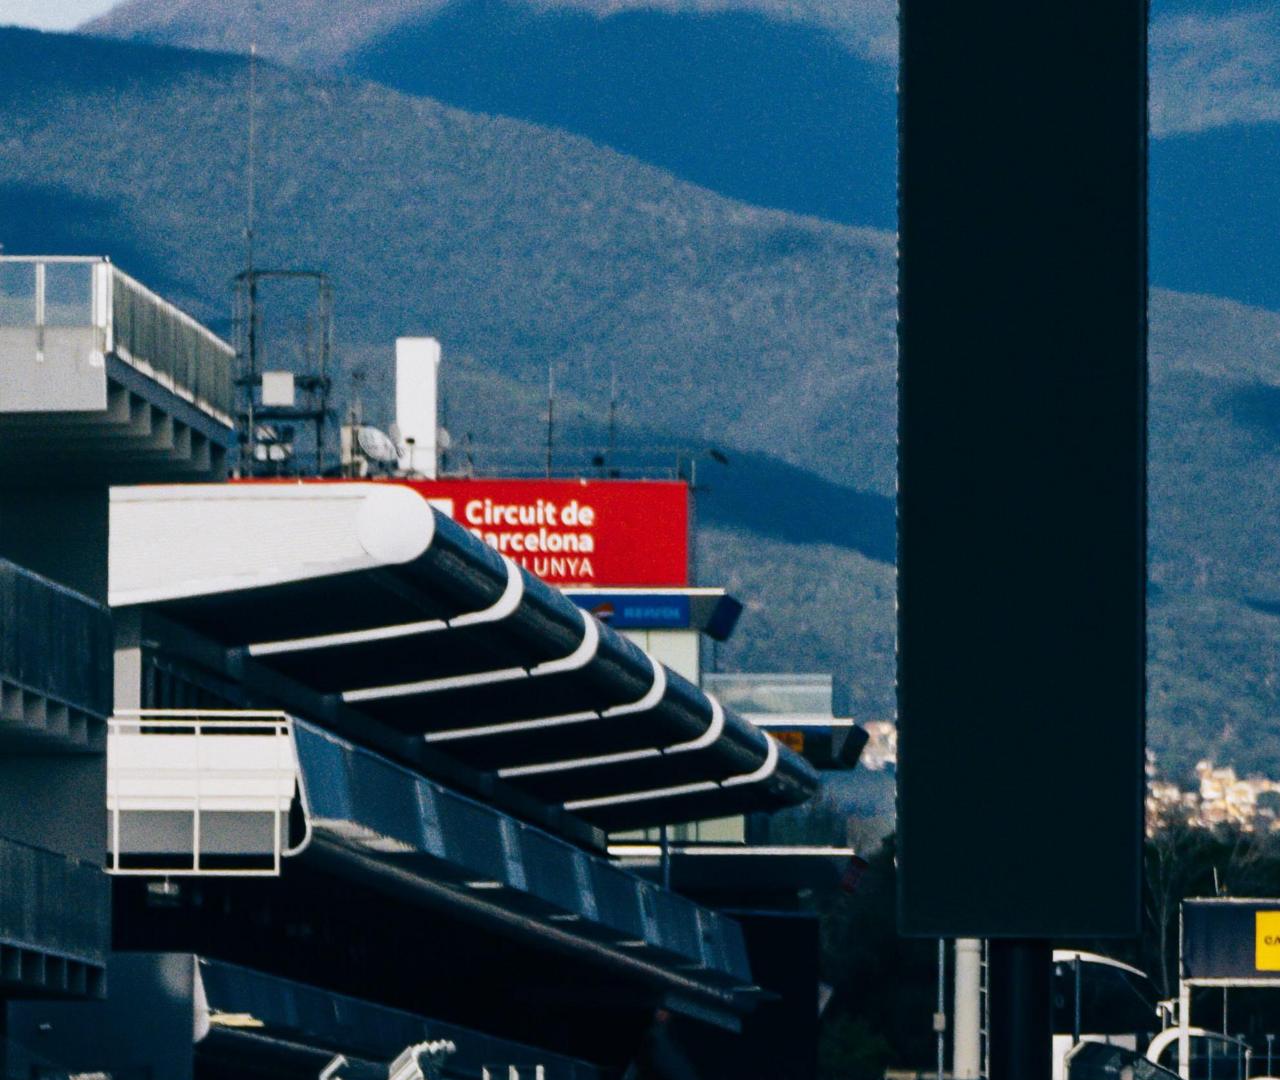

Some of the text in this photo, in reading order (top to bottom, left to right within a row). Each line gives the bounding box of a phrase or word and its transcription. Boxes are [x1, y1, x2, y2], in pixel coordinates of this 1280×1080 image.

[465, 499, 594, 526] Circuit de
[469, 528, 594, 552] arcelona
